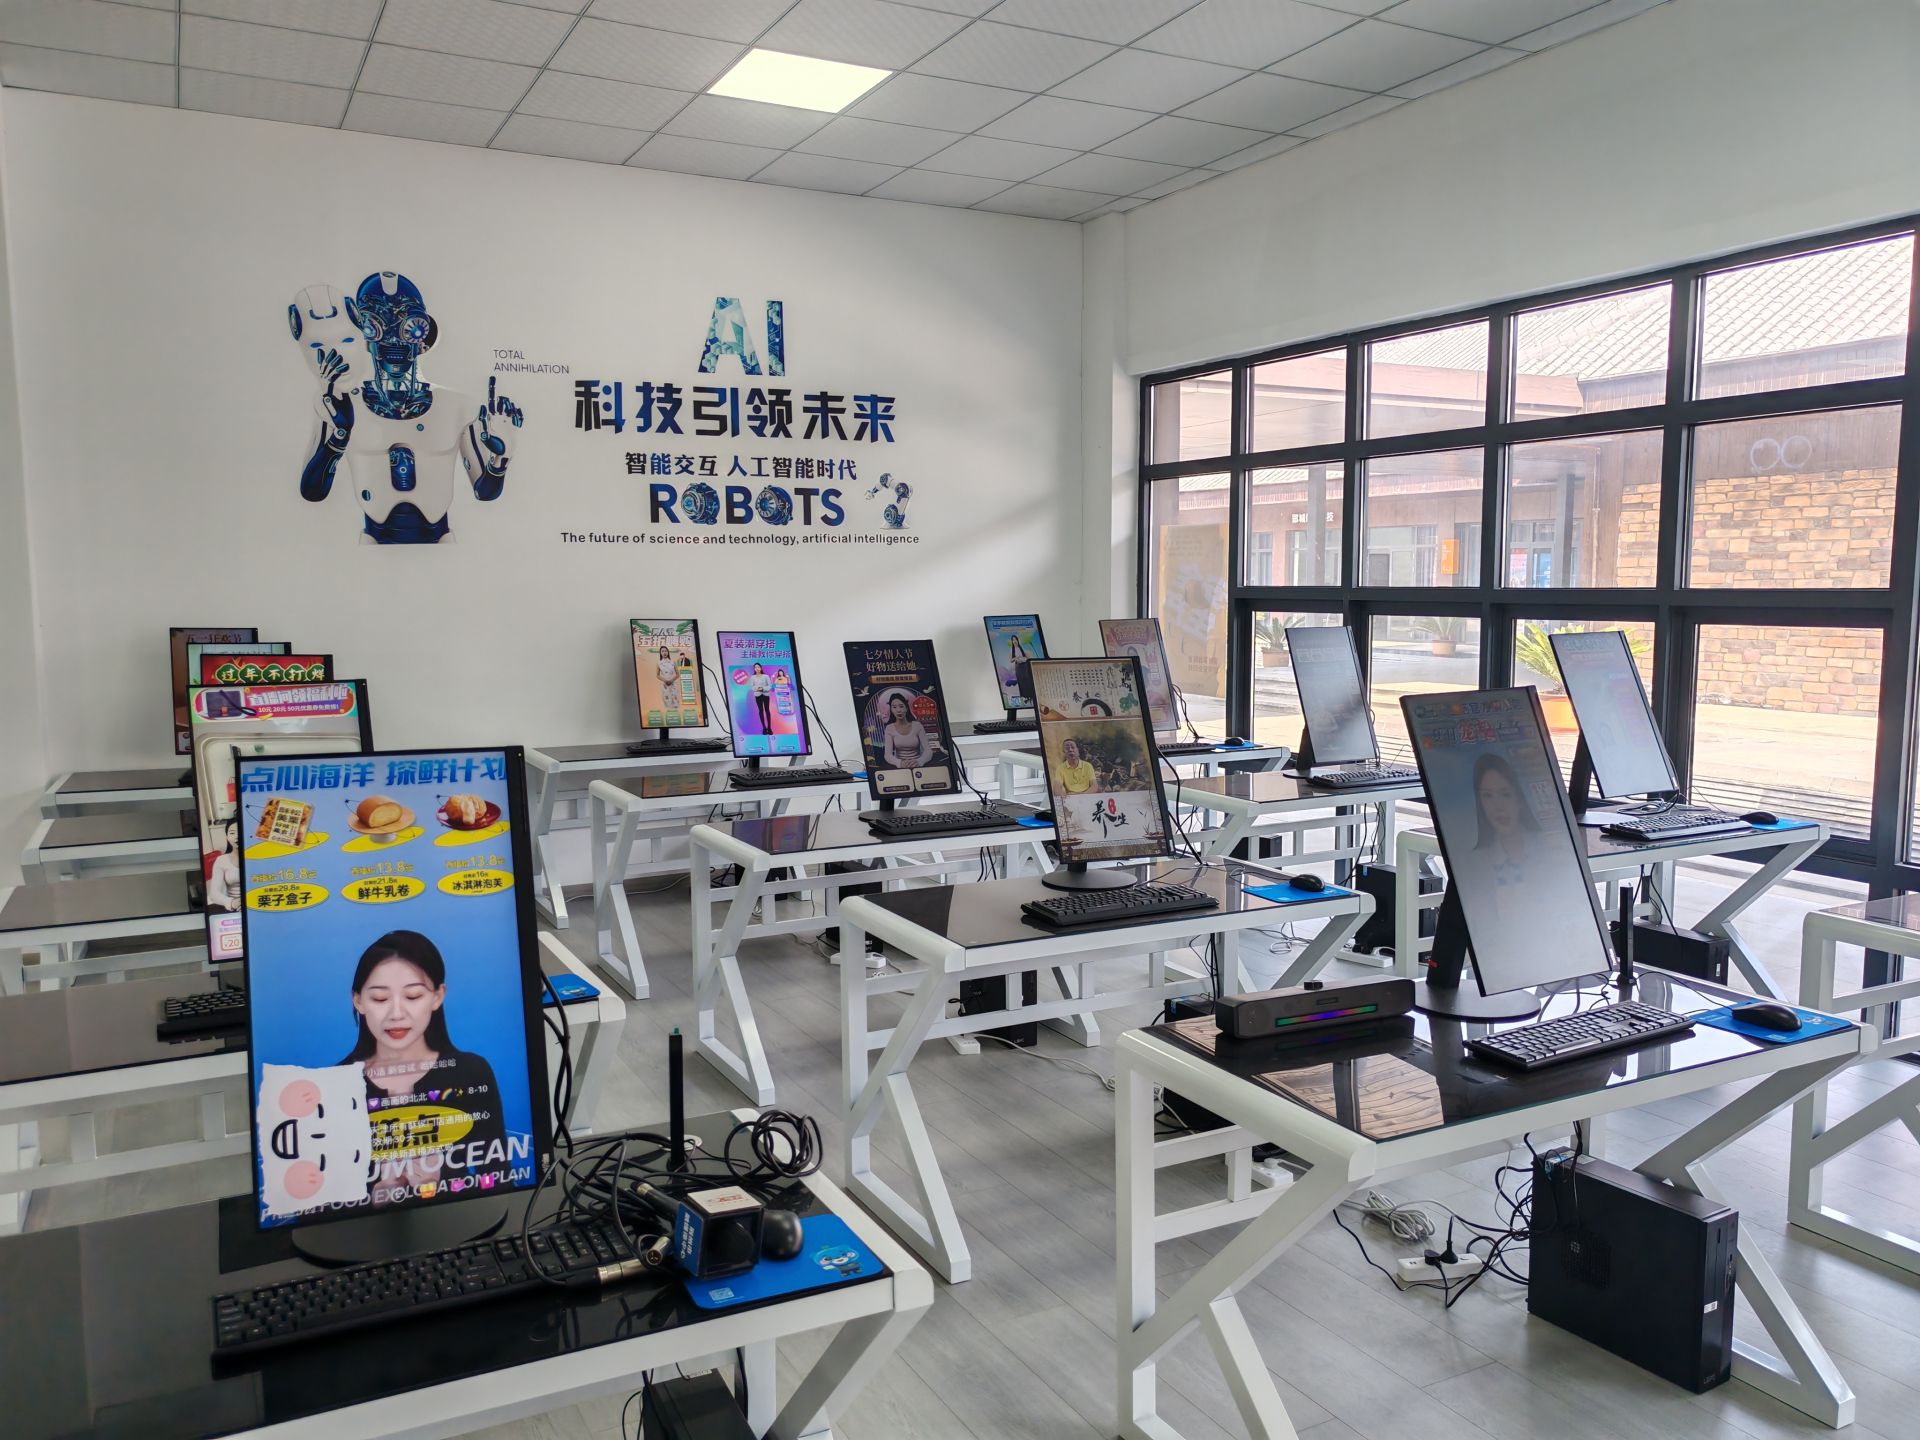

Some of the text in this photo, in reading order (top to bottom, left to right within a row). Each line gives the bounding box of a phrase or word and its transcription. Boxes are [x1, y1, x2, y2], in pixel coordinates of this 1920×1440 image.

[698, 296, 786, 377] AI
[493, 349, 525, 360] TOTAL
[493, 362, 570, 375] ANNIHILATION
[574, 379, 896, 443] 科技引领未来
[625, 451, 857, 481] 智能交互 人工智能时代
[649, 482, 845, 527] ROBOTS
[561, 532, 919, 547] The future of science and technology, artificial intelligence
[864, 648, 913, 660] 七夕情人节
[866, 660, 917, 673] 好物送给她
[220, 668, 326, 683] 过年不打烊
[241, 756, 508, 793] 点心海洋 探鲜计划
[358, 884, 410, 899] 鲜牛乳卷
[452, 878, 503, 890] 冰淇淋泡芙
[468, 1084, 489, 1095] 8-10
[421, 1134, 529, 1172] OCEAN
